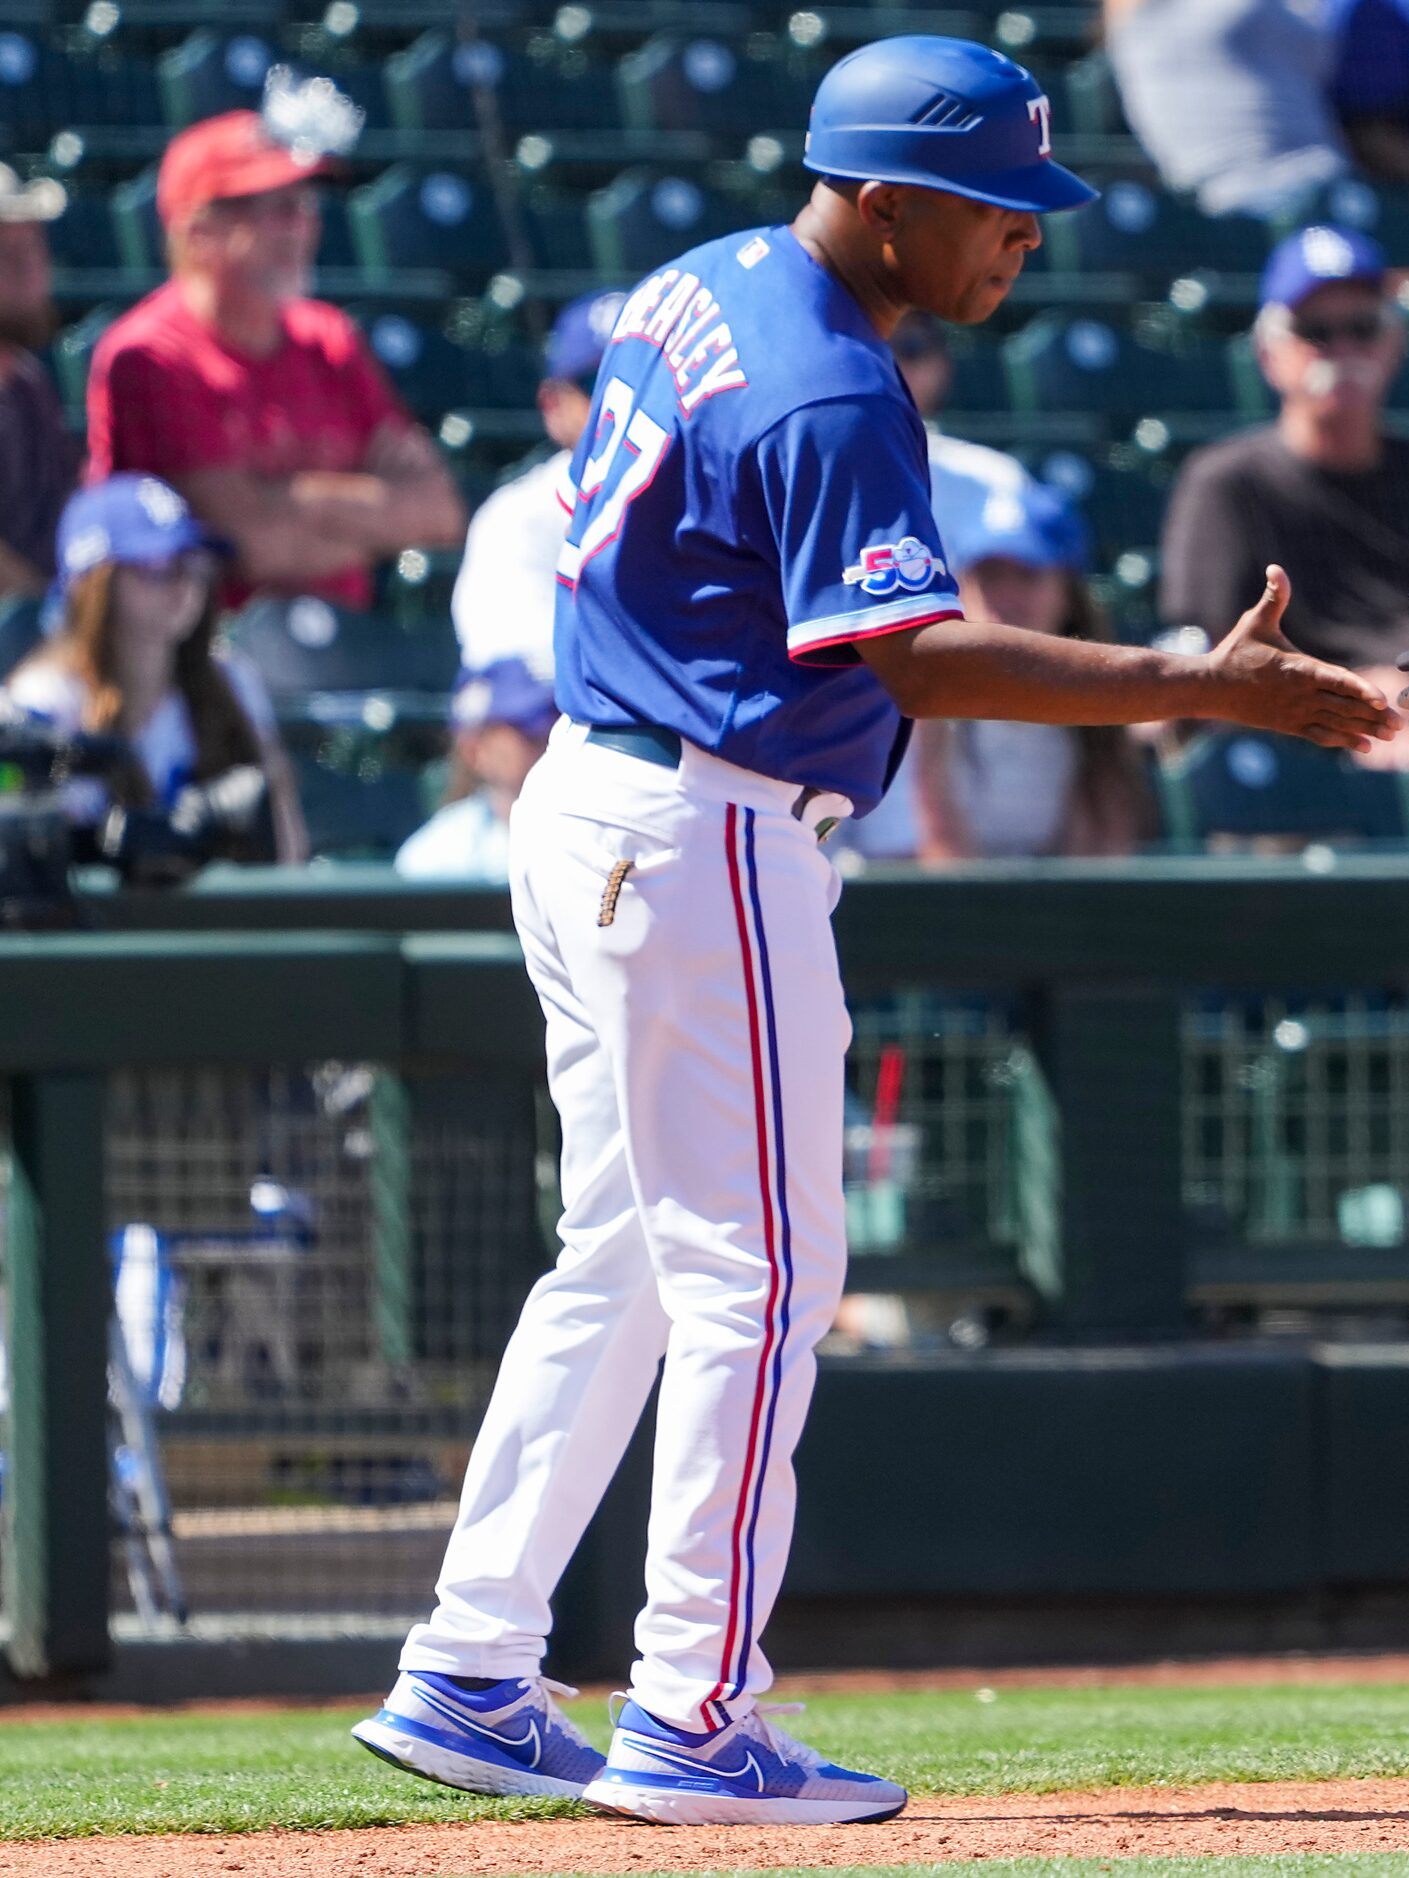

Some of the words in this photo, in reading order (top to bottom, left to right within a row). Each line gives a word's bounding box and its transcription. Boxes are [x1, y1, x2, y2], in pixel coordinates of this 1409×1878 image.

[1027, 94, 1052, 159] T
[609, 269, 749, 420] BEASLEY
[556, 376, 672, 602] 27
[860, 536, 934, 595] 50
